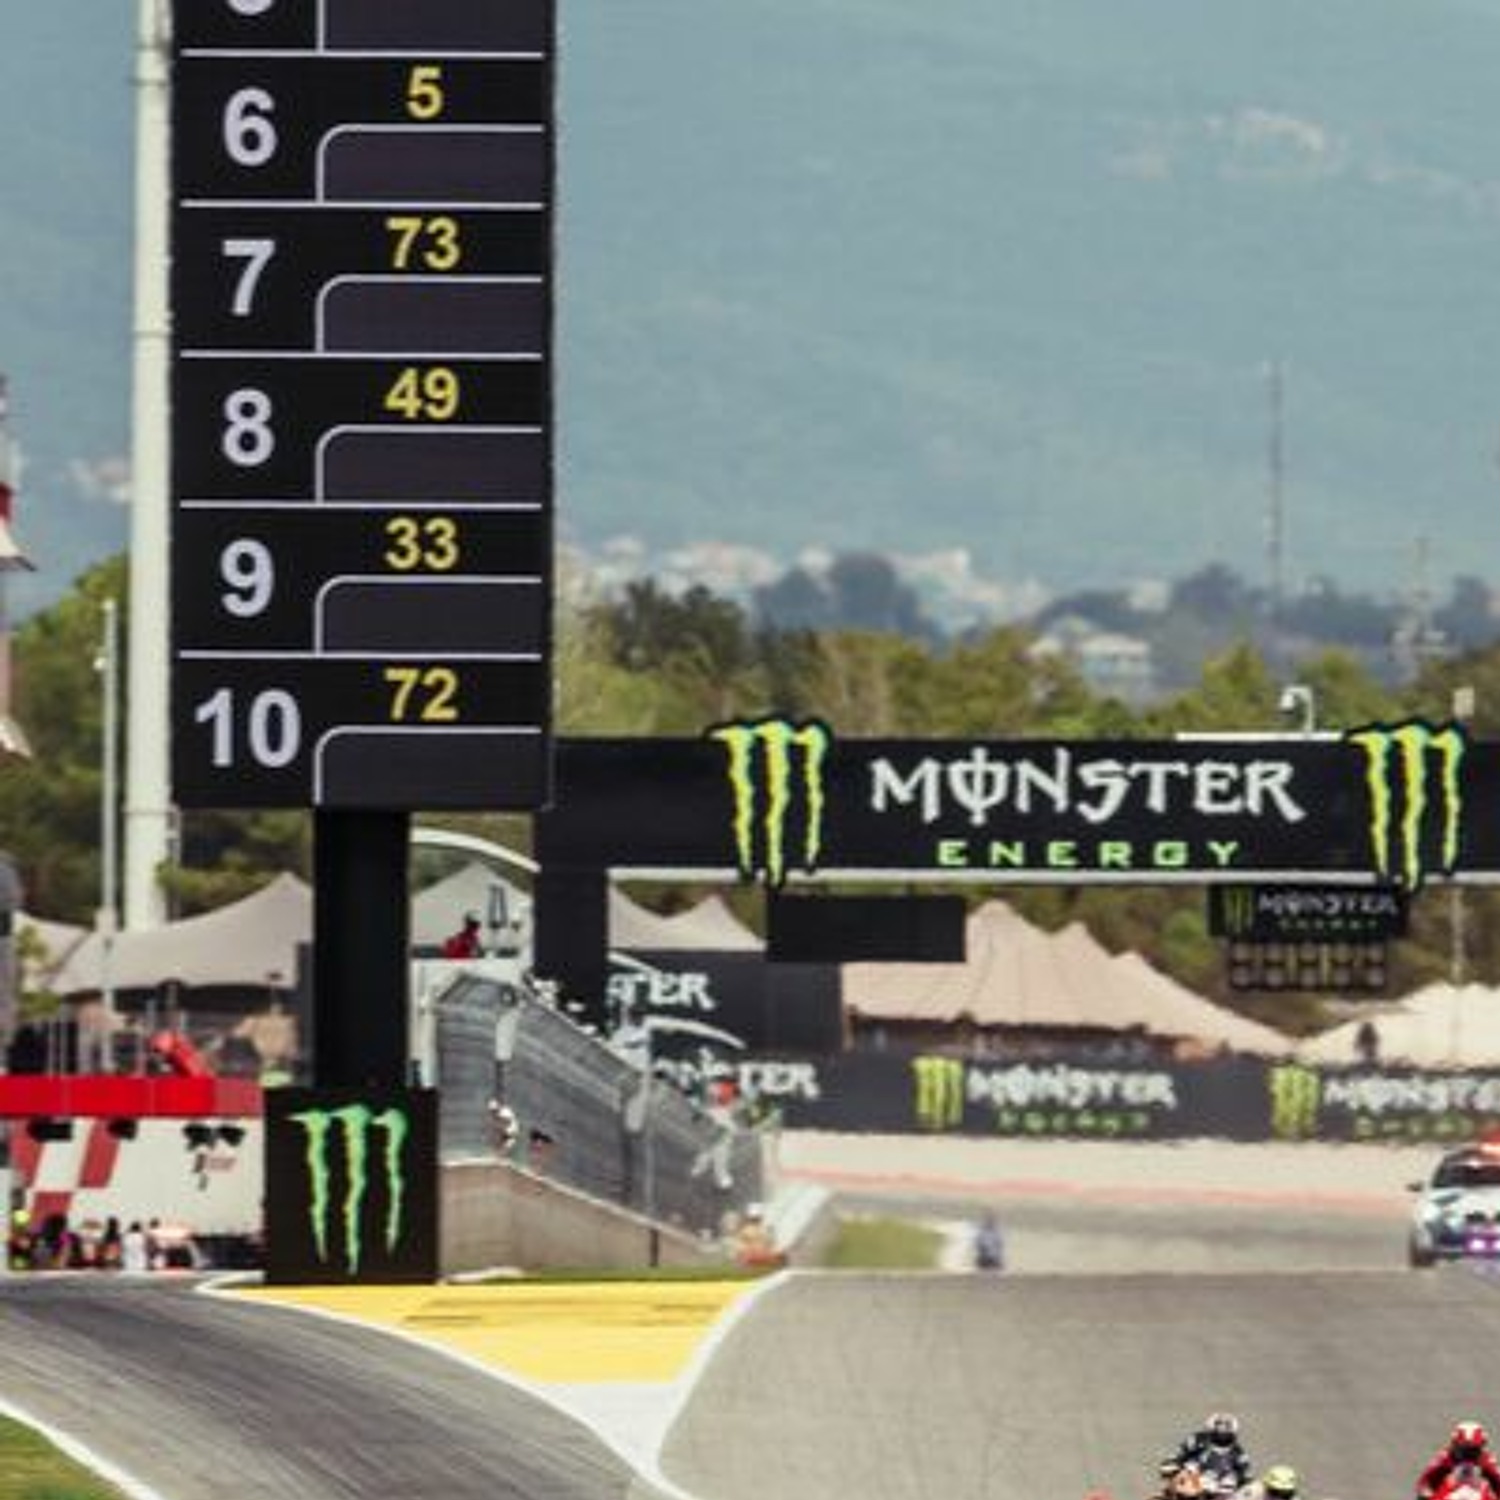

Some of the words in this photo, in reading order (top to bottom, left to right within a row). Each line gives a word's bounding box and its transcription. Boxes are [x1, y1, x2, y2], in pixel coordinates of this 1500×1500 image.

[407, 66, 443, 118] 5
[224, 88, 277, 166] 6
[387, 217, 460, 270] 73
[224, 240, 275, 315] 7
[385, 368, 459, 419] 49
[224, 389, 274, 467] 8
[386, 518, 459, 569] 33
[221, 540, 274, 617] 9
[384, 668, 459, 720] 72
[195, 687, 301, 768] 10
[870, 747, 1306, 826] MONSTER
[937, 839, 1239, 867] ENERGY
